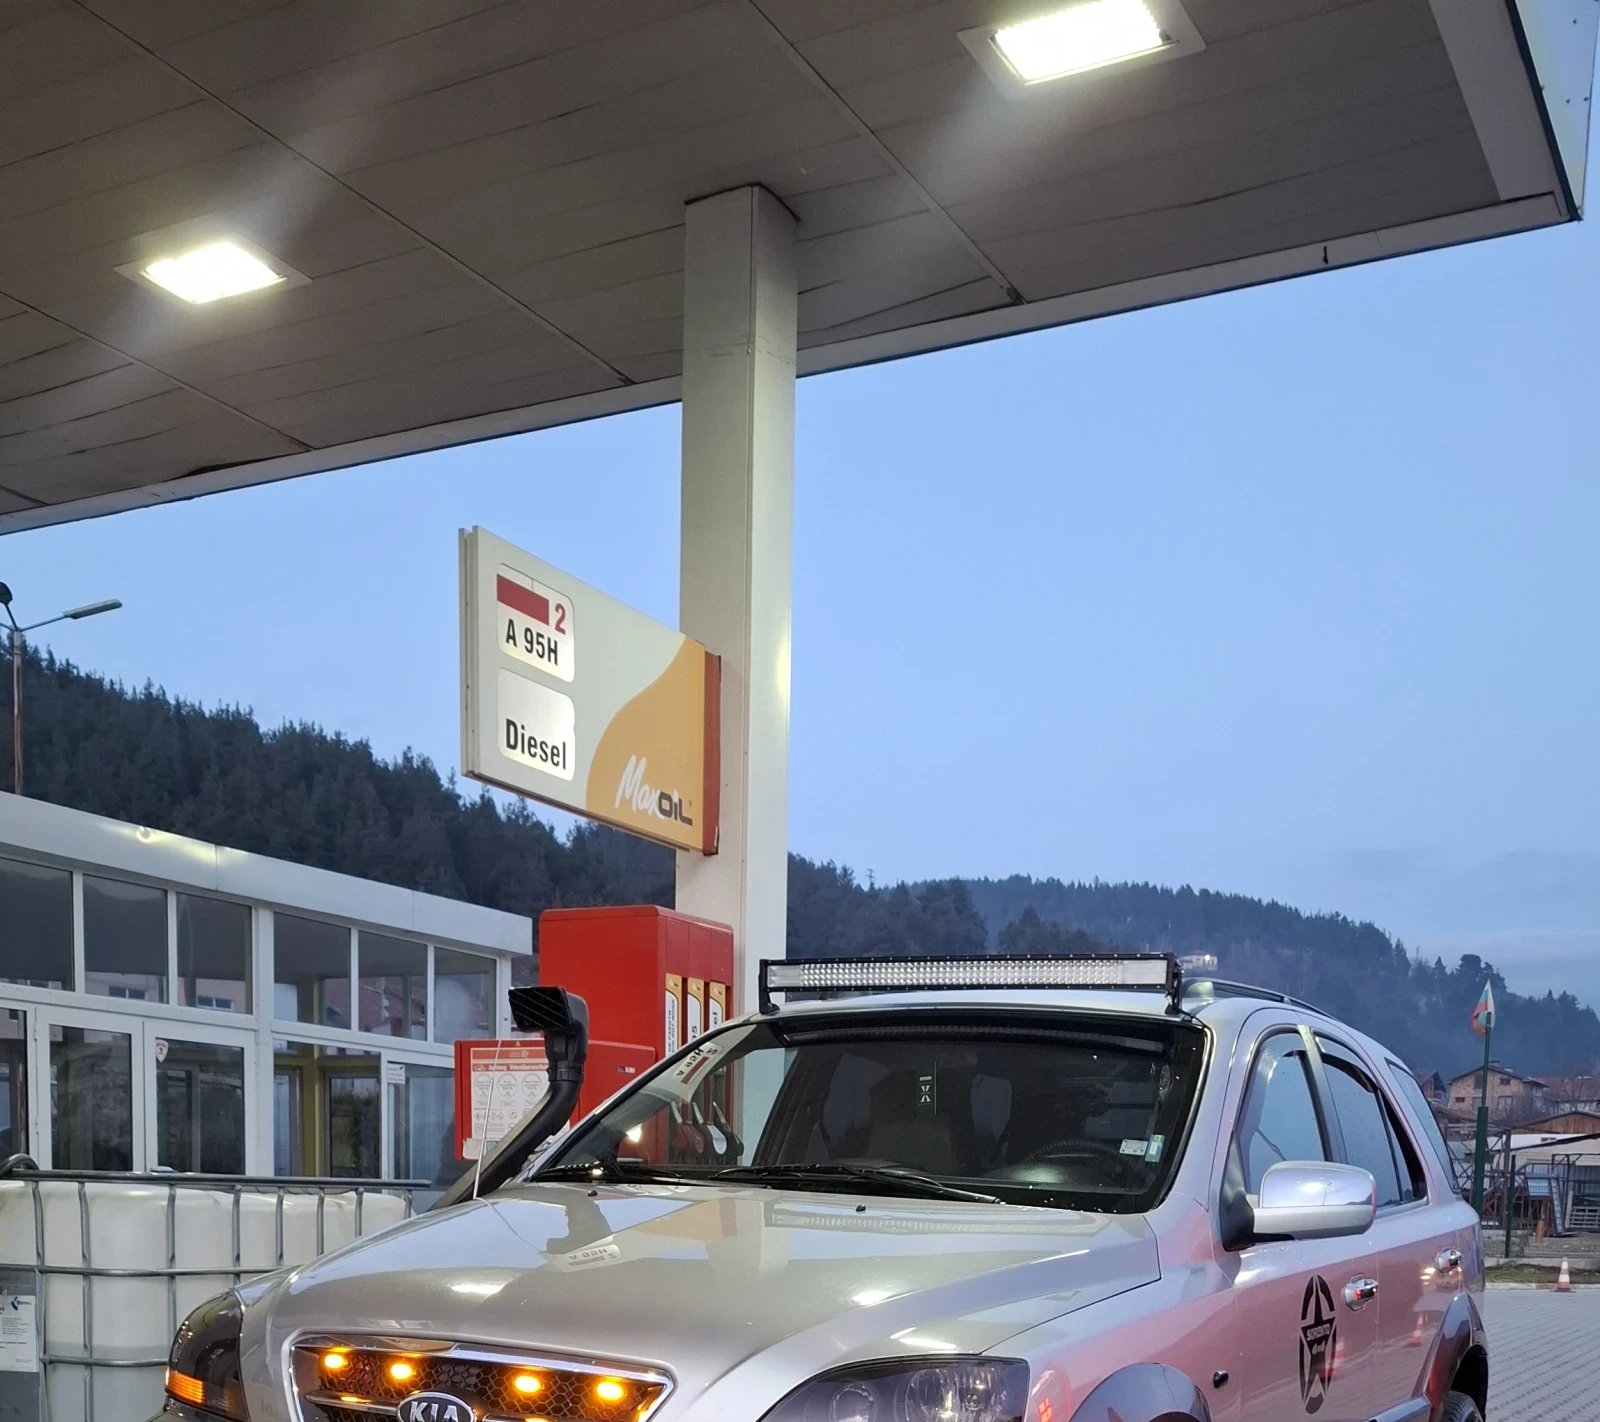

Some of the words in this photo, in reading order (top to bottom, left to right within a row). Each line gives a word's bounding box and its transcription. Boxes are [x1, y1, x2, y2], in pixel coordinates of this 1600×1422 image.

[505, 618, 517, 648] A
[524, 627, 558, 665] 95H
[554, 603, 566, 635] 2
[506, 718, 566, 770] Diesel
